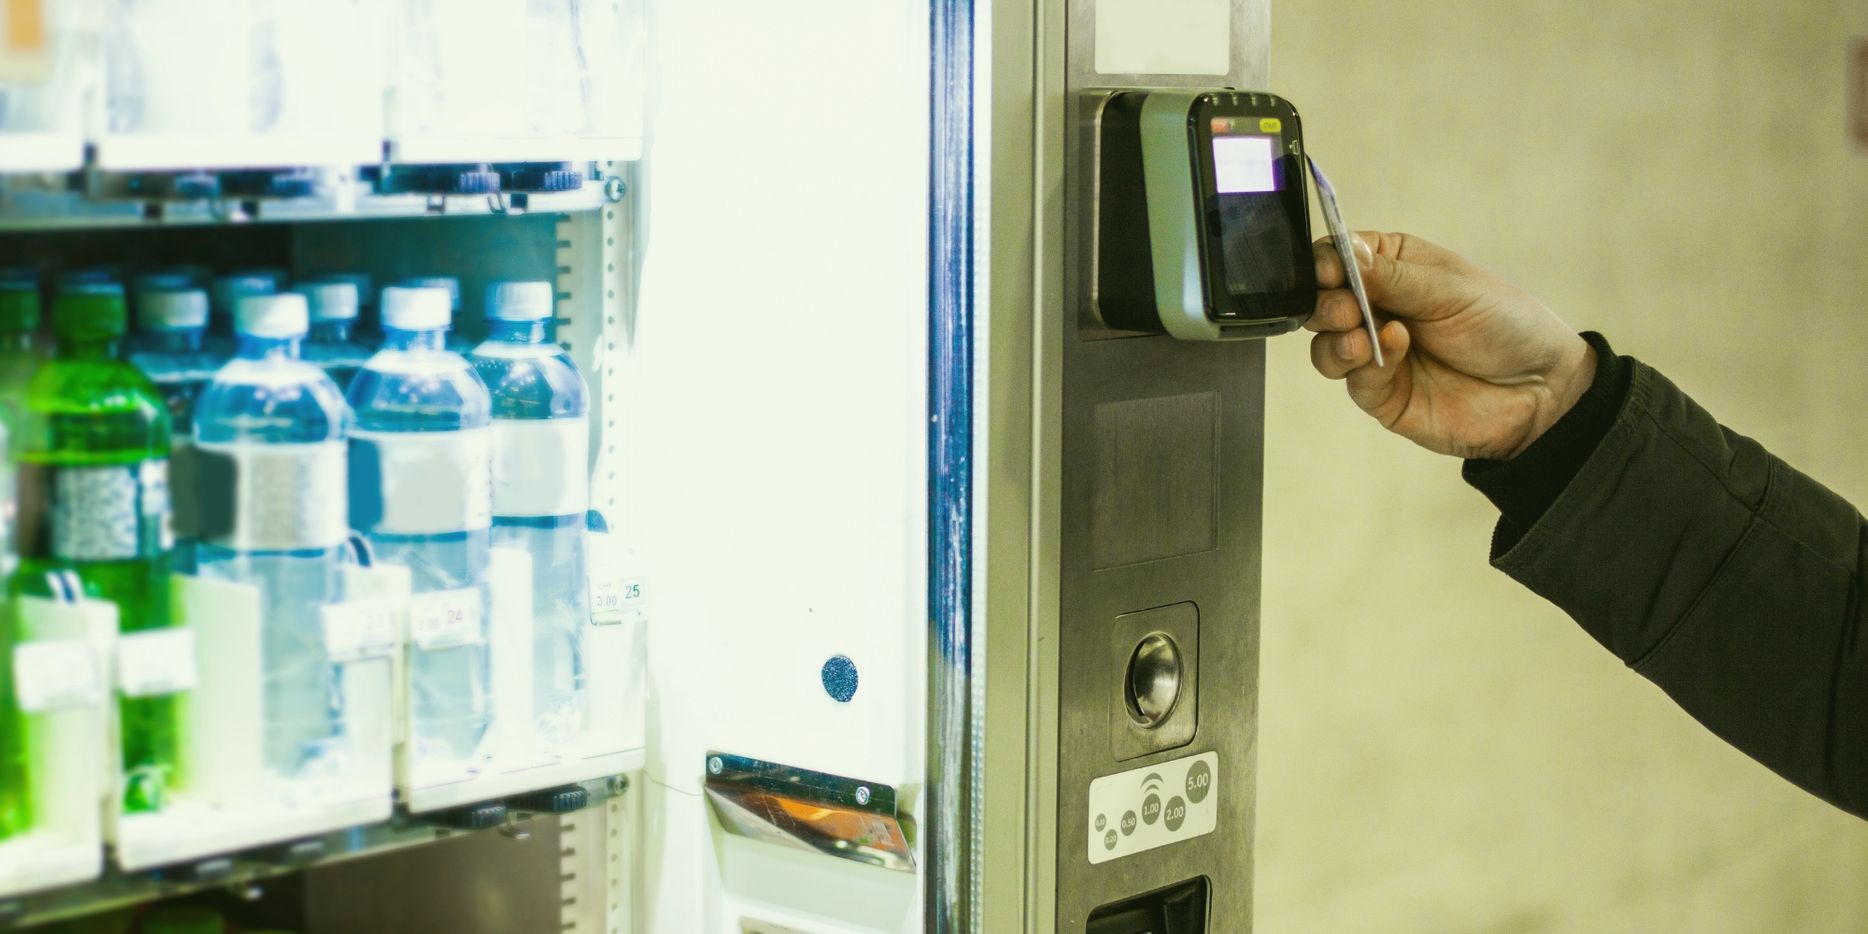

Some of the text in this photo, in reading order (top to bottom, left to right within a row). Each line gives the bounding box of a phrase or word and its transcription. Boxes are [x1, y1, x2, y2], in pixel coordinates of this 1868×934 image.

[625, 584, 640, 599] 25
[447, 609, 464, 625] 24
[1188, 773, 1209, 790] 5.00
[1144, 802, 1159, 816] 1.00
[1166, 806, 1184, 821] 2.00
[1121, 817, 1136, 829] 0.50
